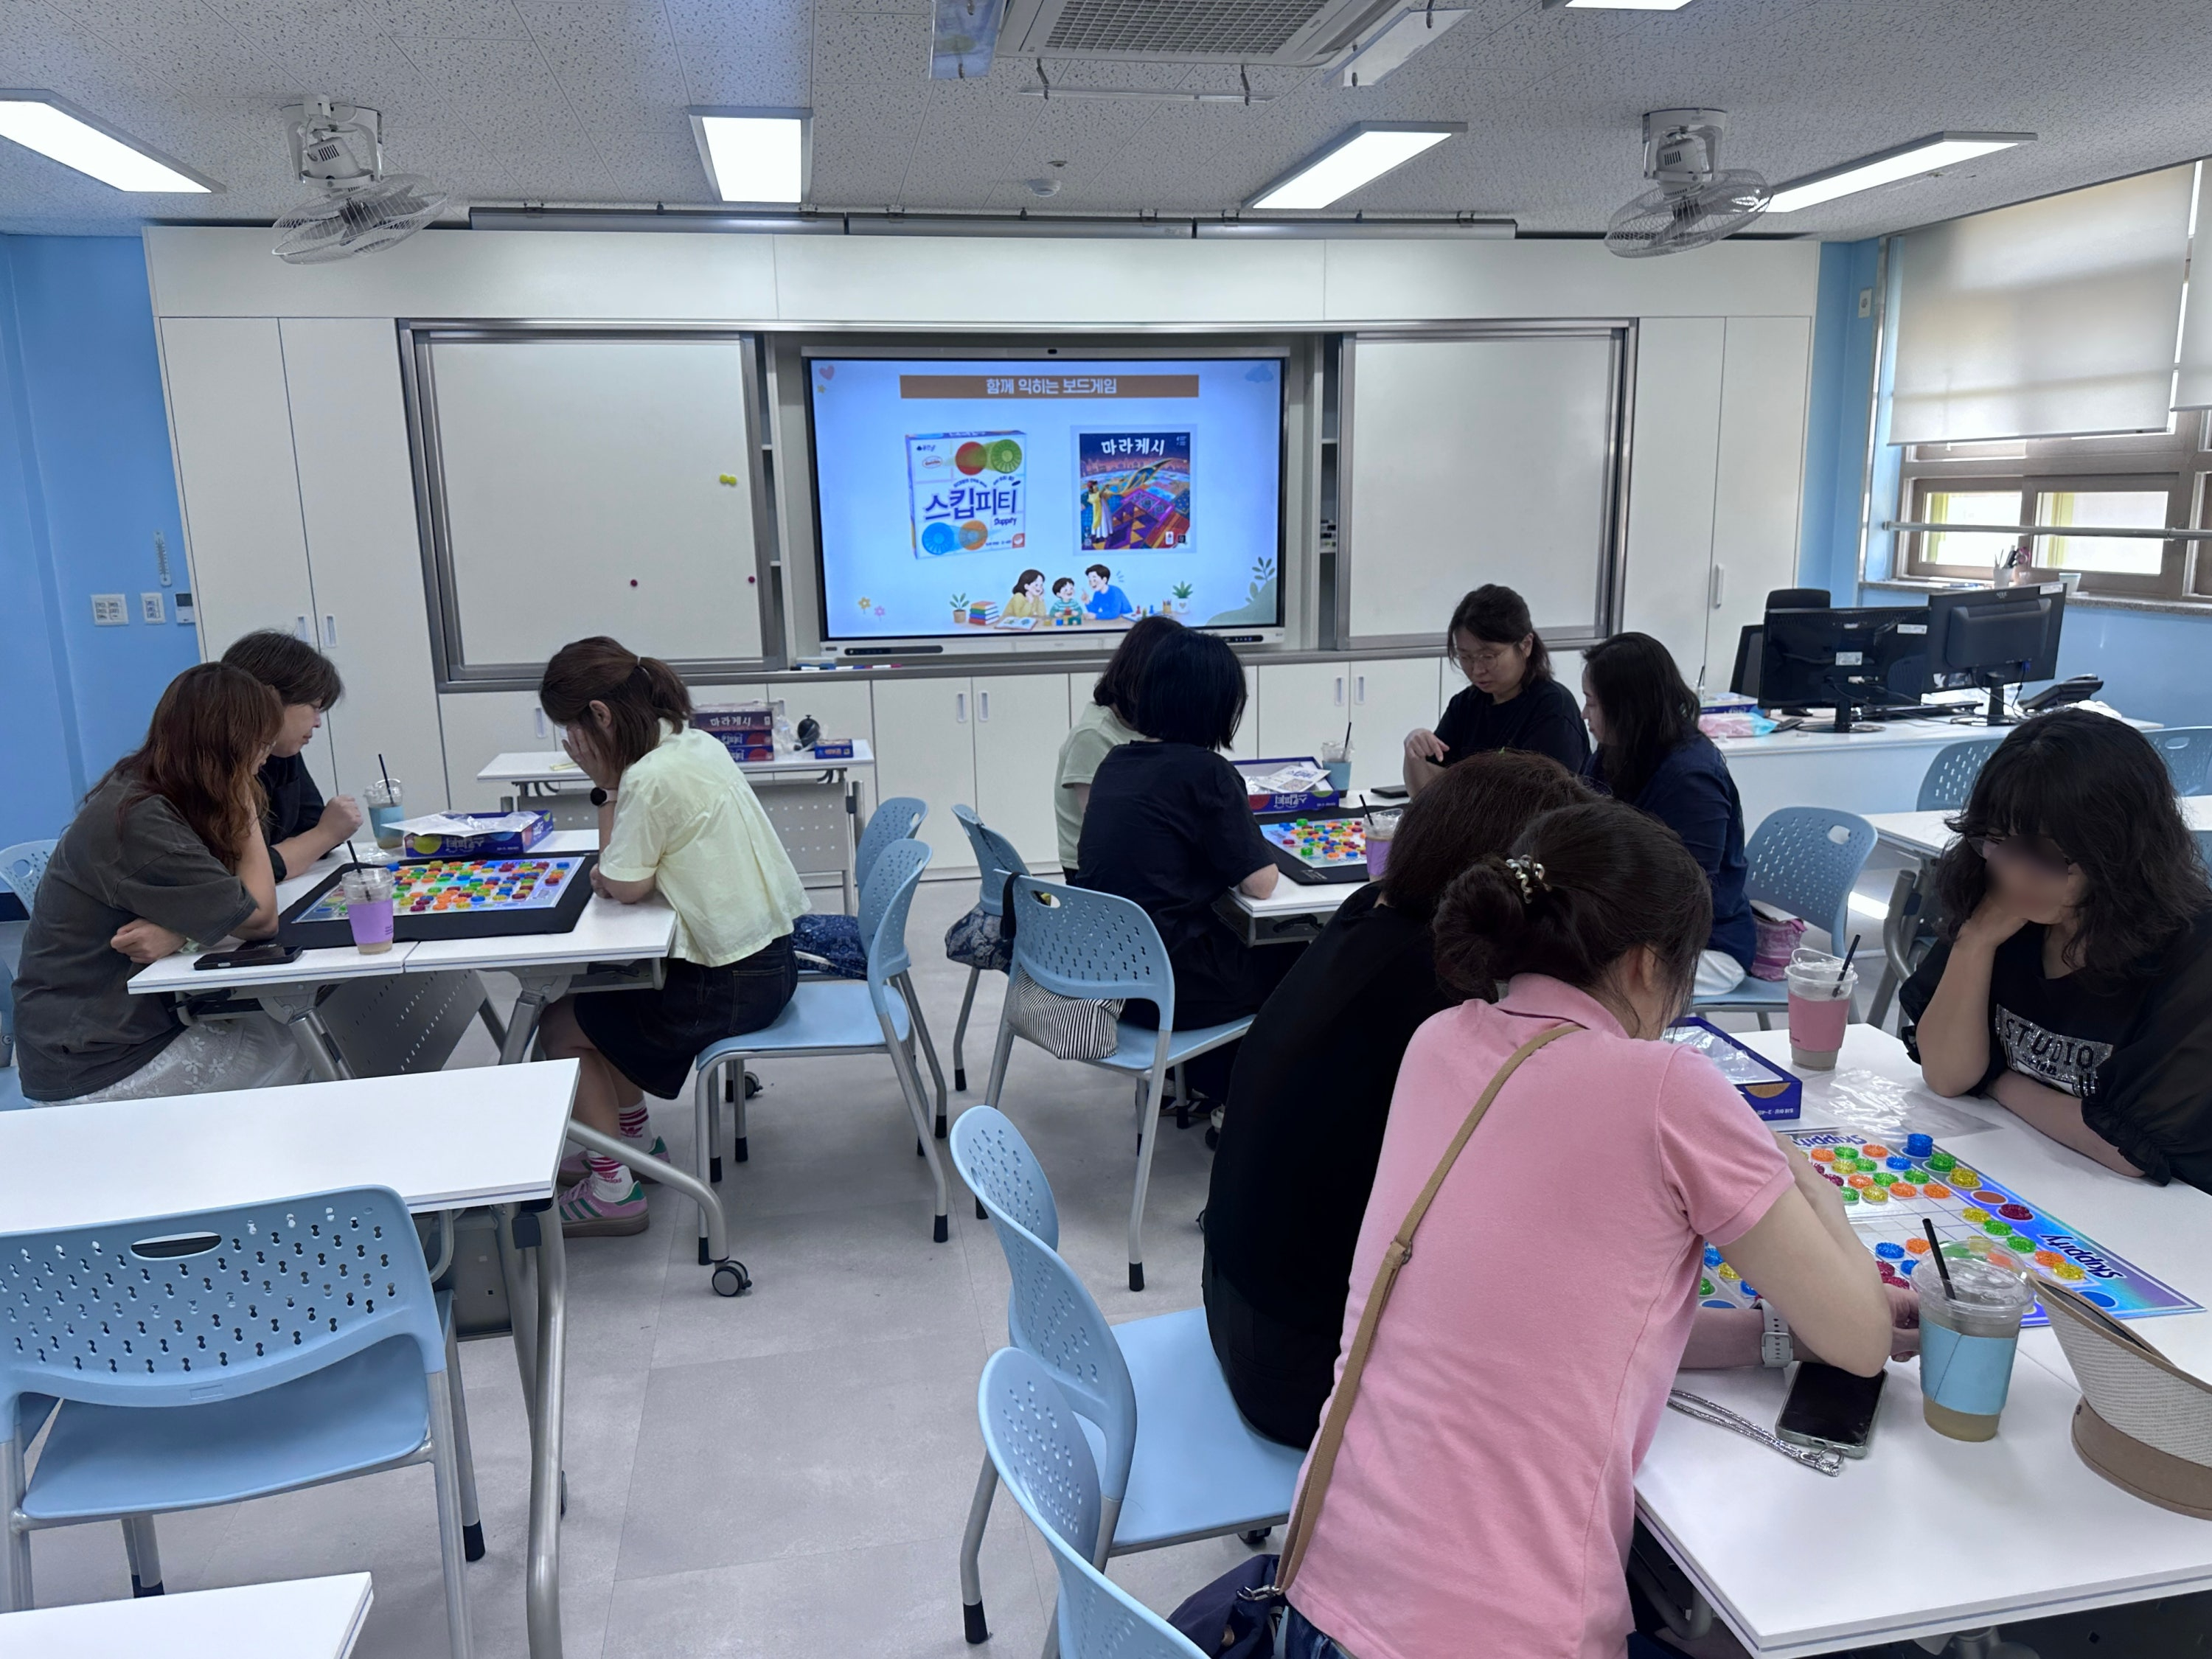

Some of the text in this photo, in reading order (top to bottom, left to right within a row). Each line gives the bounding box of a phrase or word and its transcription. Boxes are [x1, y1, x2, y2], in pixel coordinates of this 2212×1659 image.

[987, 378, 1117, 394] 함께 익히는 보드게임
[1101, 437, 1165, 456] 마라케시
[925, 487, 1016, 520] 스킵피티
[721, 733, 743, 745] 킵피티
[2005, 1018, 2094, 1068] STUDIO
